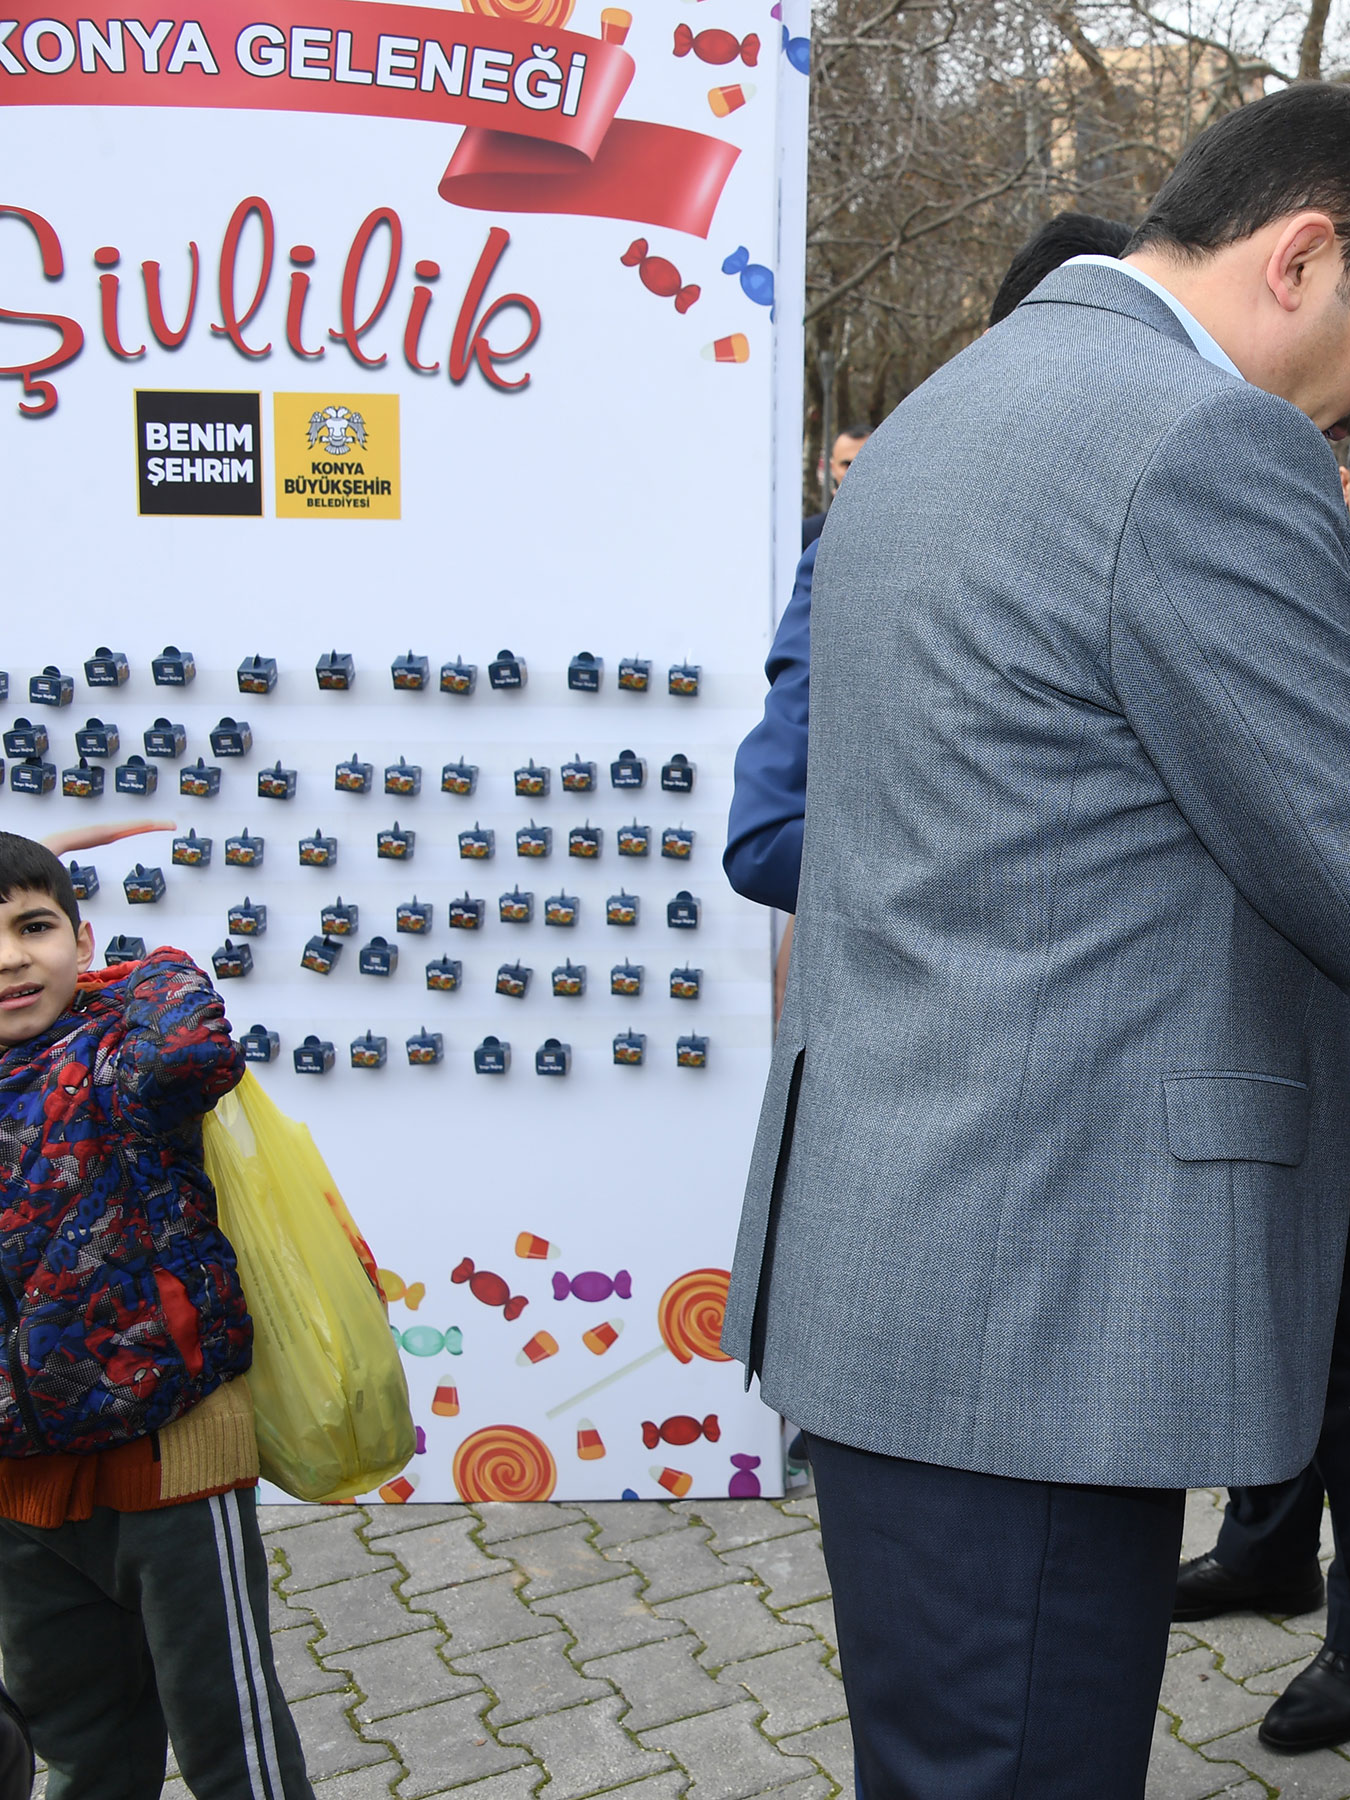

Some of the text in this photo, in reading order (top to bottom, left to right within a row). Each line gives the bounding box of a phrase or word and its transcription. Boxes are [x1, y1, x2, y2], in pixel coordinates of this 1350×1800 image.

[235, 22, 588, 117] GELENEĞİ
[311, 461, 365, 475] KONYA
[284, 475, 392, 496] BÜYÜKŞEHİR
[306, 496, 370, 508] BELEDİYESİ
